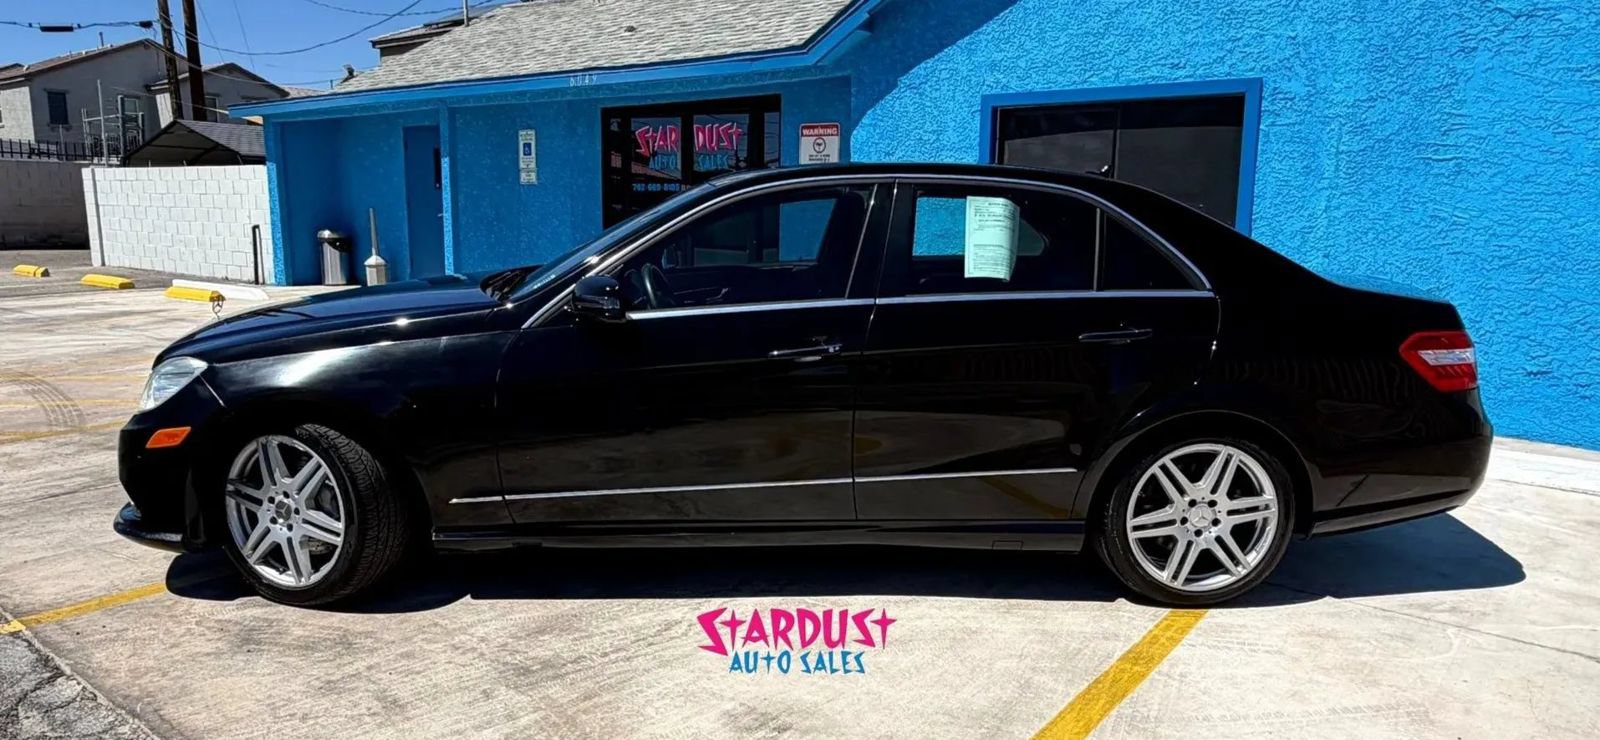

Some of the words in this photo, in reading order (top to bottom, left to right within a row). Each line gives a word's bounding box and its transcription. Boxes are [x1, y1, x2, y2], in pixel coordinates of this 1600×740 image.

[802, 126, 838, 136] WARNING
[650, 153, 677, 170] AUTO
[698, 153, 729, 170] SALES
